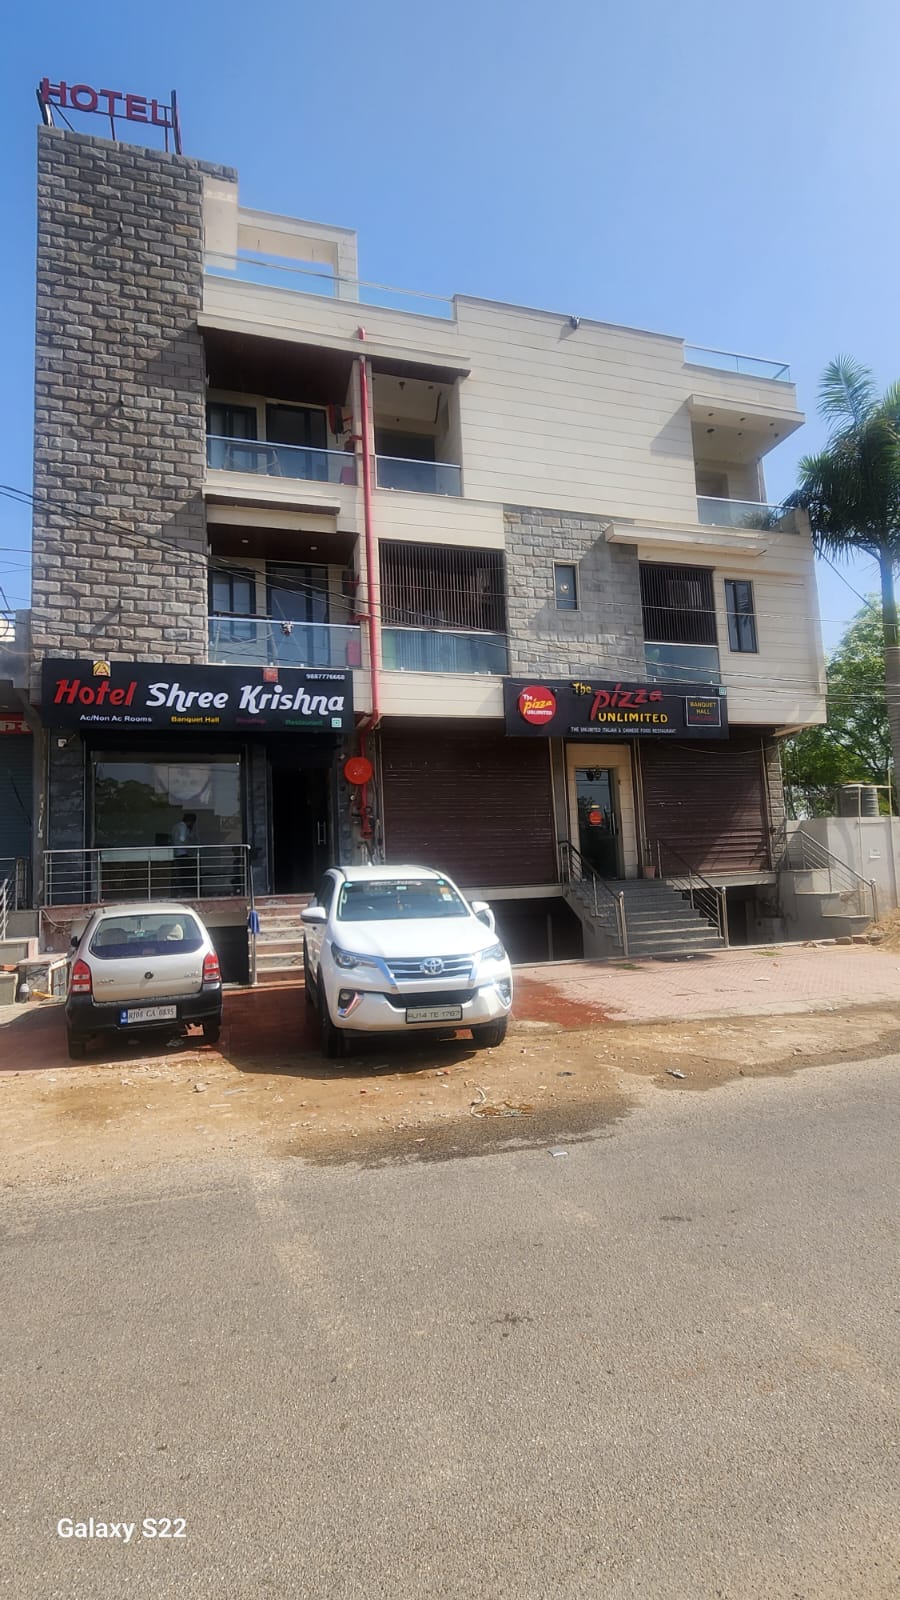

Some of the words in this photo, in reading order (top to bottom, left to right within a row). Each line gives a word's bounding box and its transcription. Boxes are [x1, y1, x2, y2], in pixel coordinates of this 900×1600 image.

[41, 78, 171, 127] HOTEL
[53, 679, 137, 706] Hotel
[146, 683, 229, 712] Shree
[239, 685, 345, 714] Krishna
[522, 693, 533, 701] The
[572, 682, 592, 696] The
[524, 698, 552, 714] pizza
[590, 683, 664, 720] pizza
[598, 713, 668, 723] UNLIMITED
